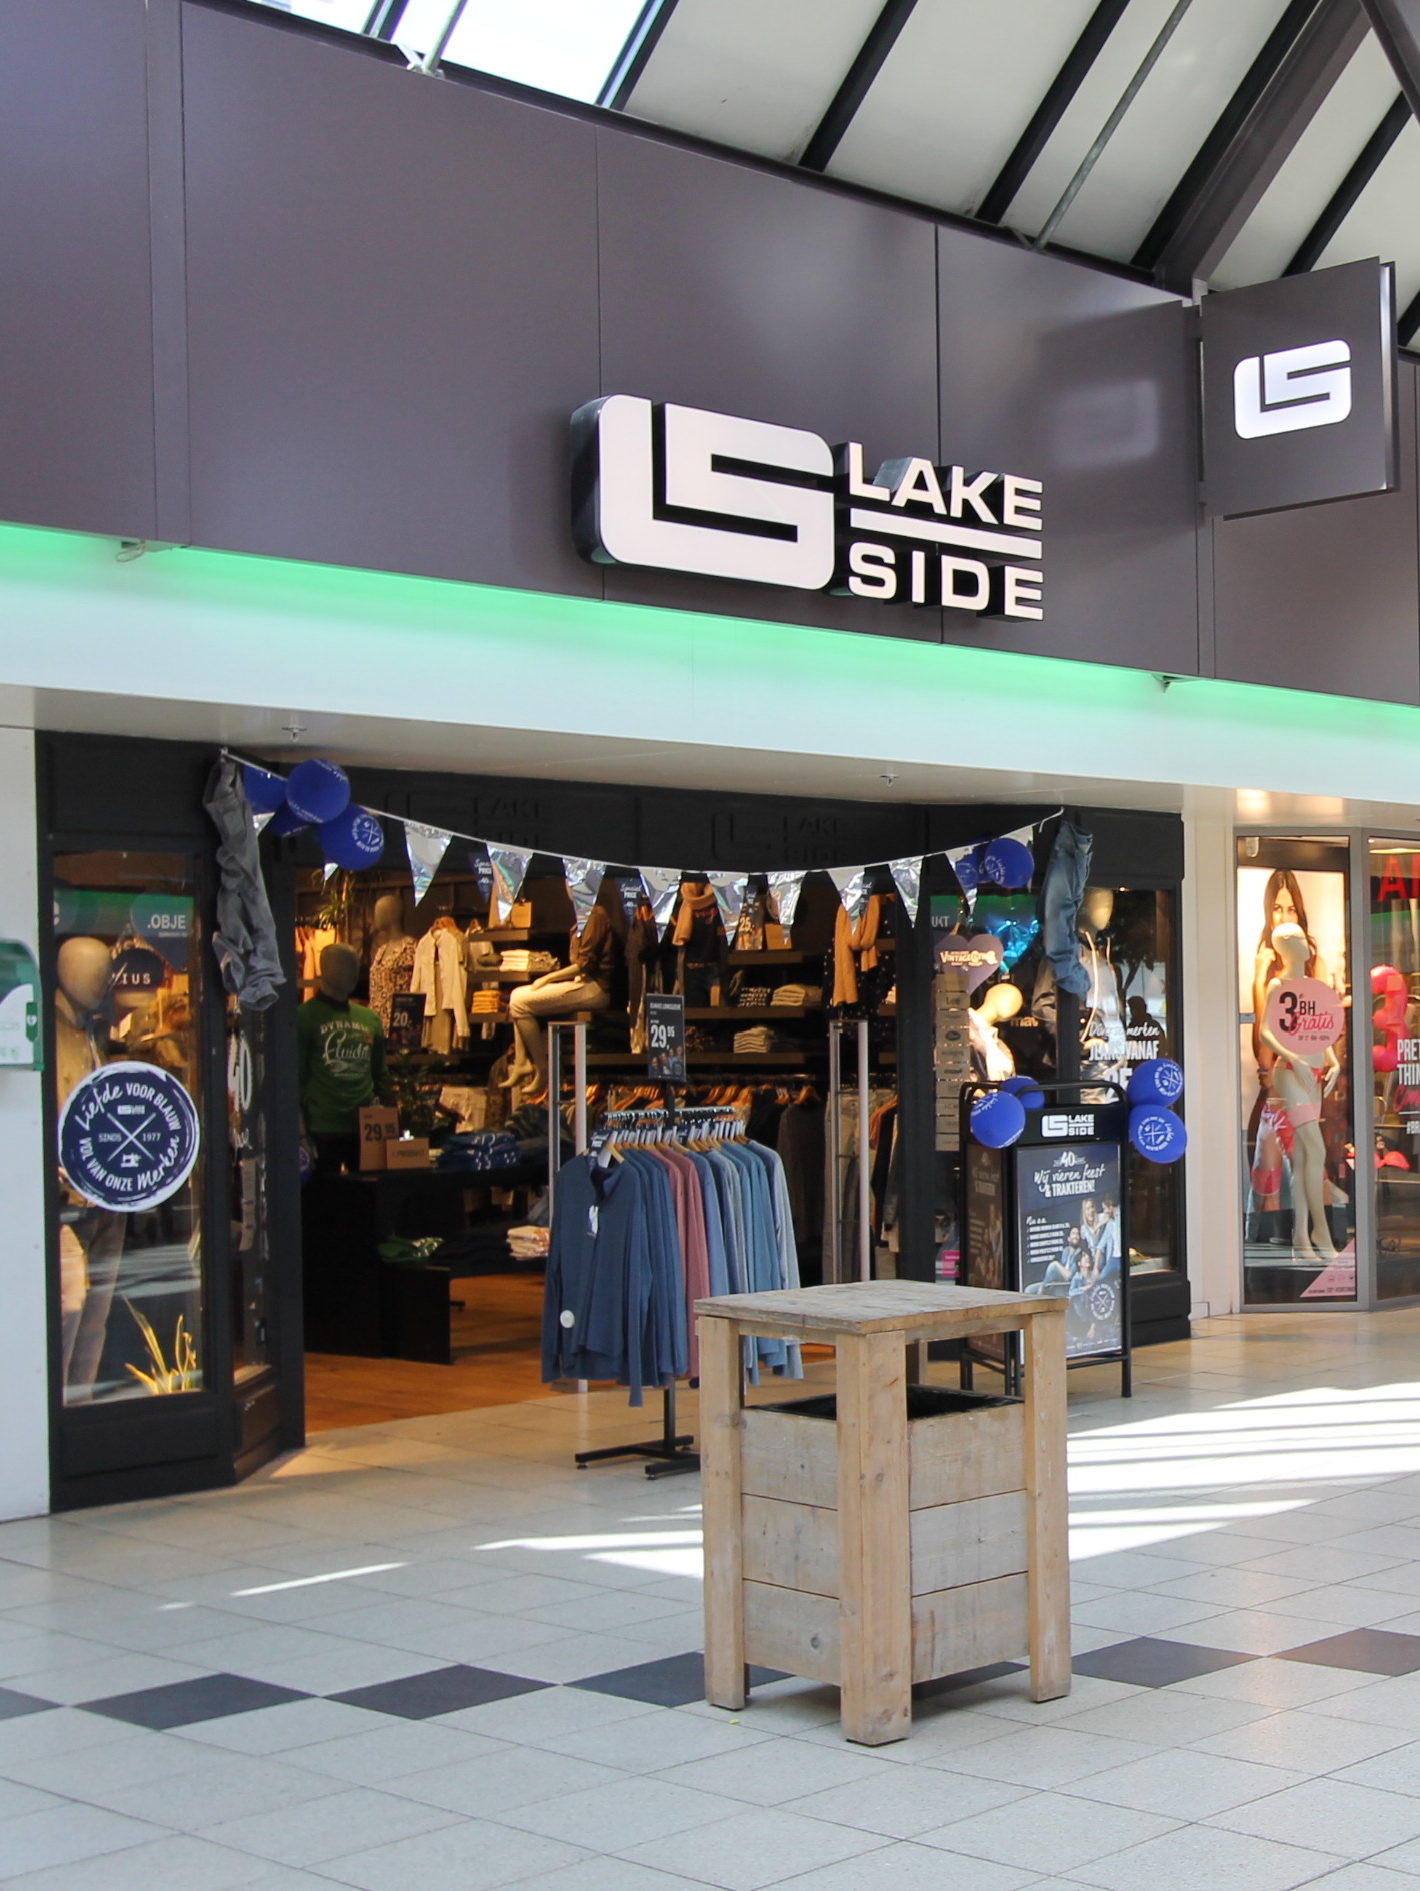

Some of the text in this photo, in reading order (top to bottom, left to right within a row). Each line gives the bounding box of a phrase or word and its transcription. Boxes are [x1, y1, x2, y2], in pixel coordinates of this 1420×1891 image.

[848, 441, 1043, 531] LAKE
[848, 541, 1044, 621] SIDE
[1300, 1000, 1315, 1016] BH
[1127, 1022, 1160, 1037] merken
[1126, 1040, 1159, 1060] VANAF
[74, 1082, 181, 1131] Liefde VOOR BLAUW
[1068, 1114, 1095, 1123] LAKE
[142, 1132, 161, 1142] 1977
[1068, 1126, 1095, 1136] SIDE
[79, 1135, 181, 1192] VOL VAN ONZE Merken
[1052, 1169, 1081, 1182] vieren
[1082, 1163, 1106, 1181] feest
[1052, 1180, 1096, 1197] TRAKTEREN!
